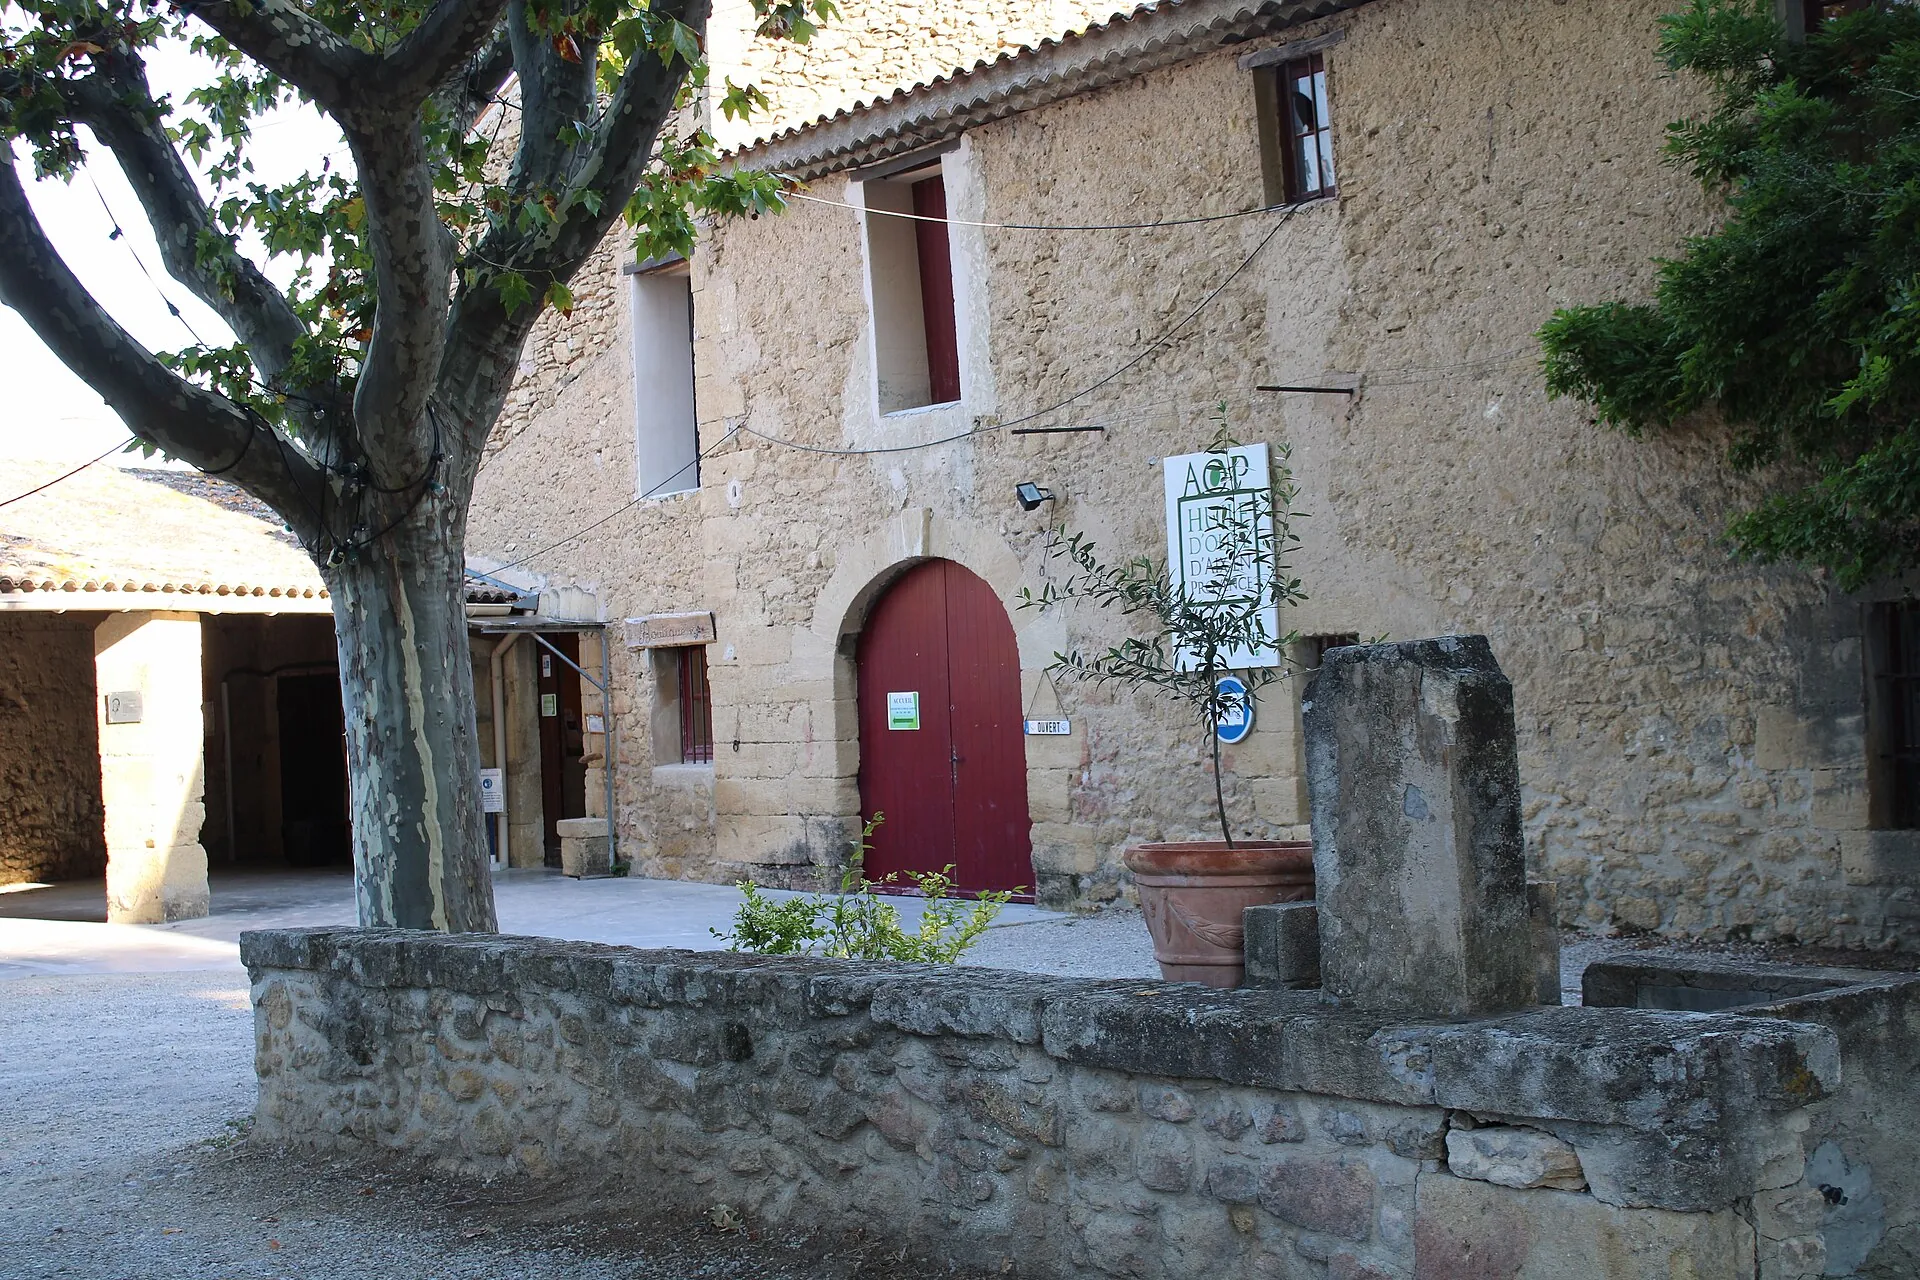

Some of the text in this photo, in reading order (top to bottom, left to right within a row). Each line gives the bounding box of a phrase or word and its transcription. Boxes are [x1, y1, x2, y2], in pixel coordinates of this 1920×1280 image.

[1184, 455, 1249, 497] AOP
[1189, 531, 1250, 555] D'OLI
[1190, 576, 1254, 595] PRONCE
[1038, 722, 1060, 732] OUVERT
